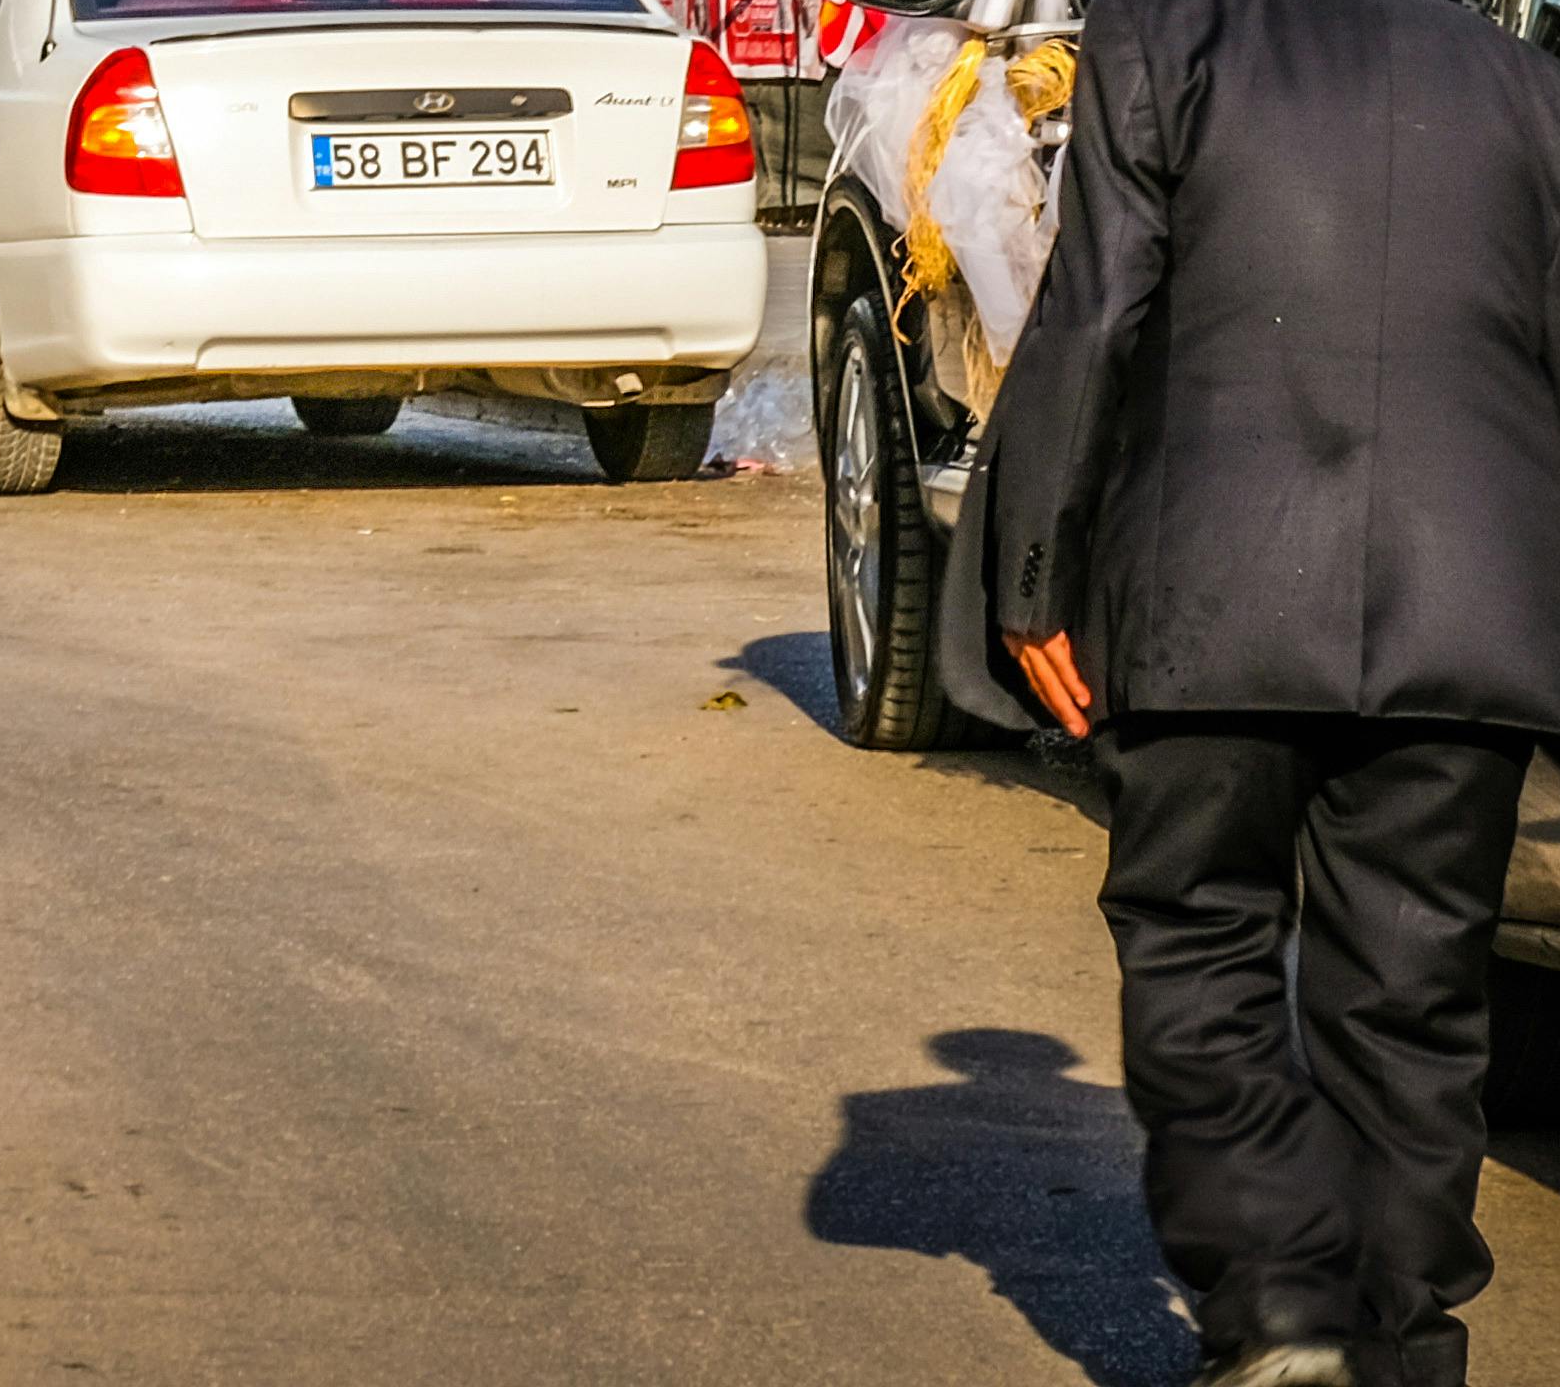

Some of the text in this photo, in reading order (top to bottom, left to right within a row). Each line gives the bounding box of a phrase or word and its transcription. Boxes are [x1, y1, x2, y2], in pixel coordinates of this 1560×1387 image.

[333, 142, 382, 181] 58
[401, 139, 457, 179] BF
[469, 137, 544, 177] 294
